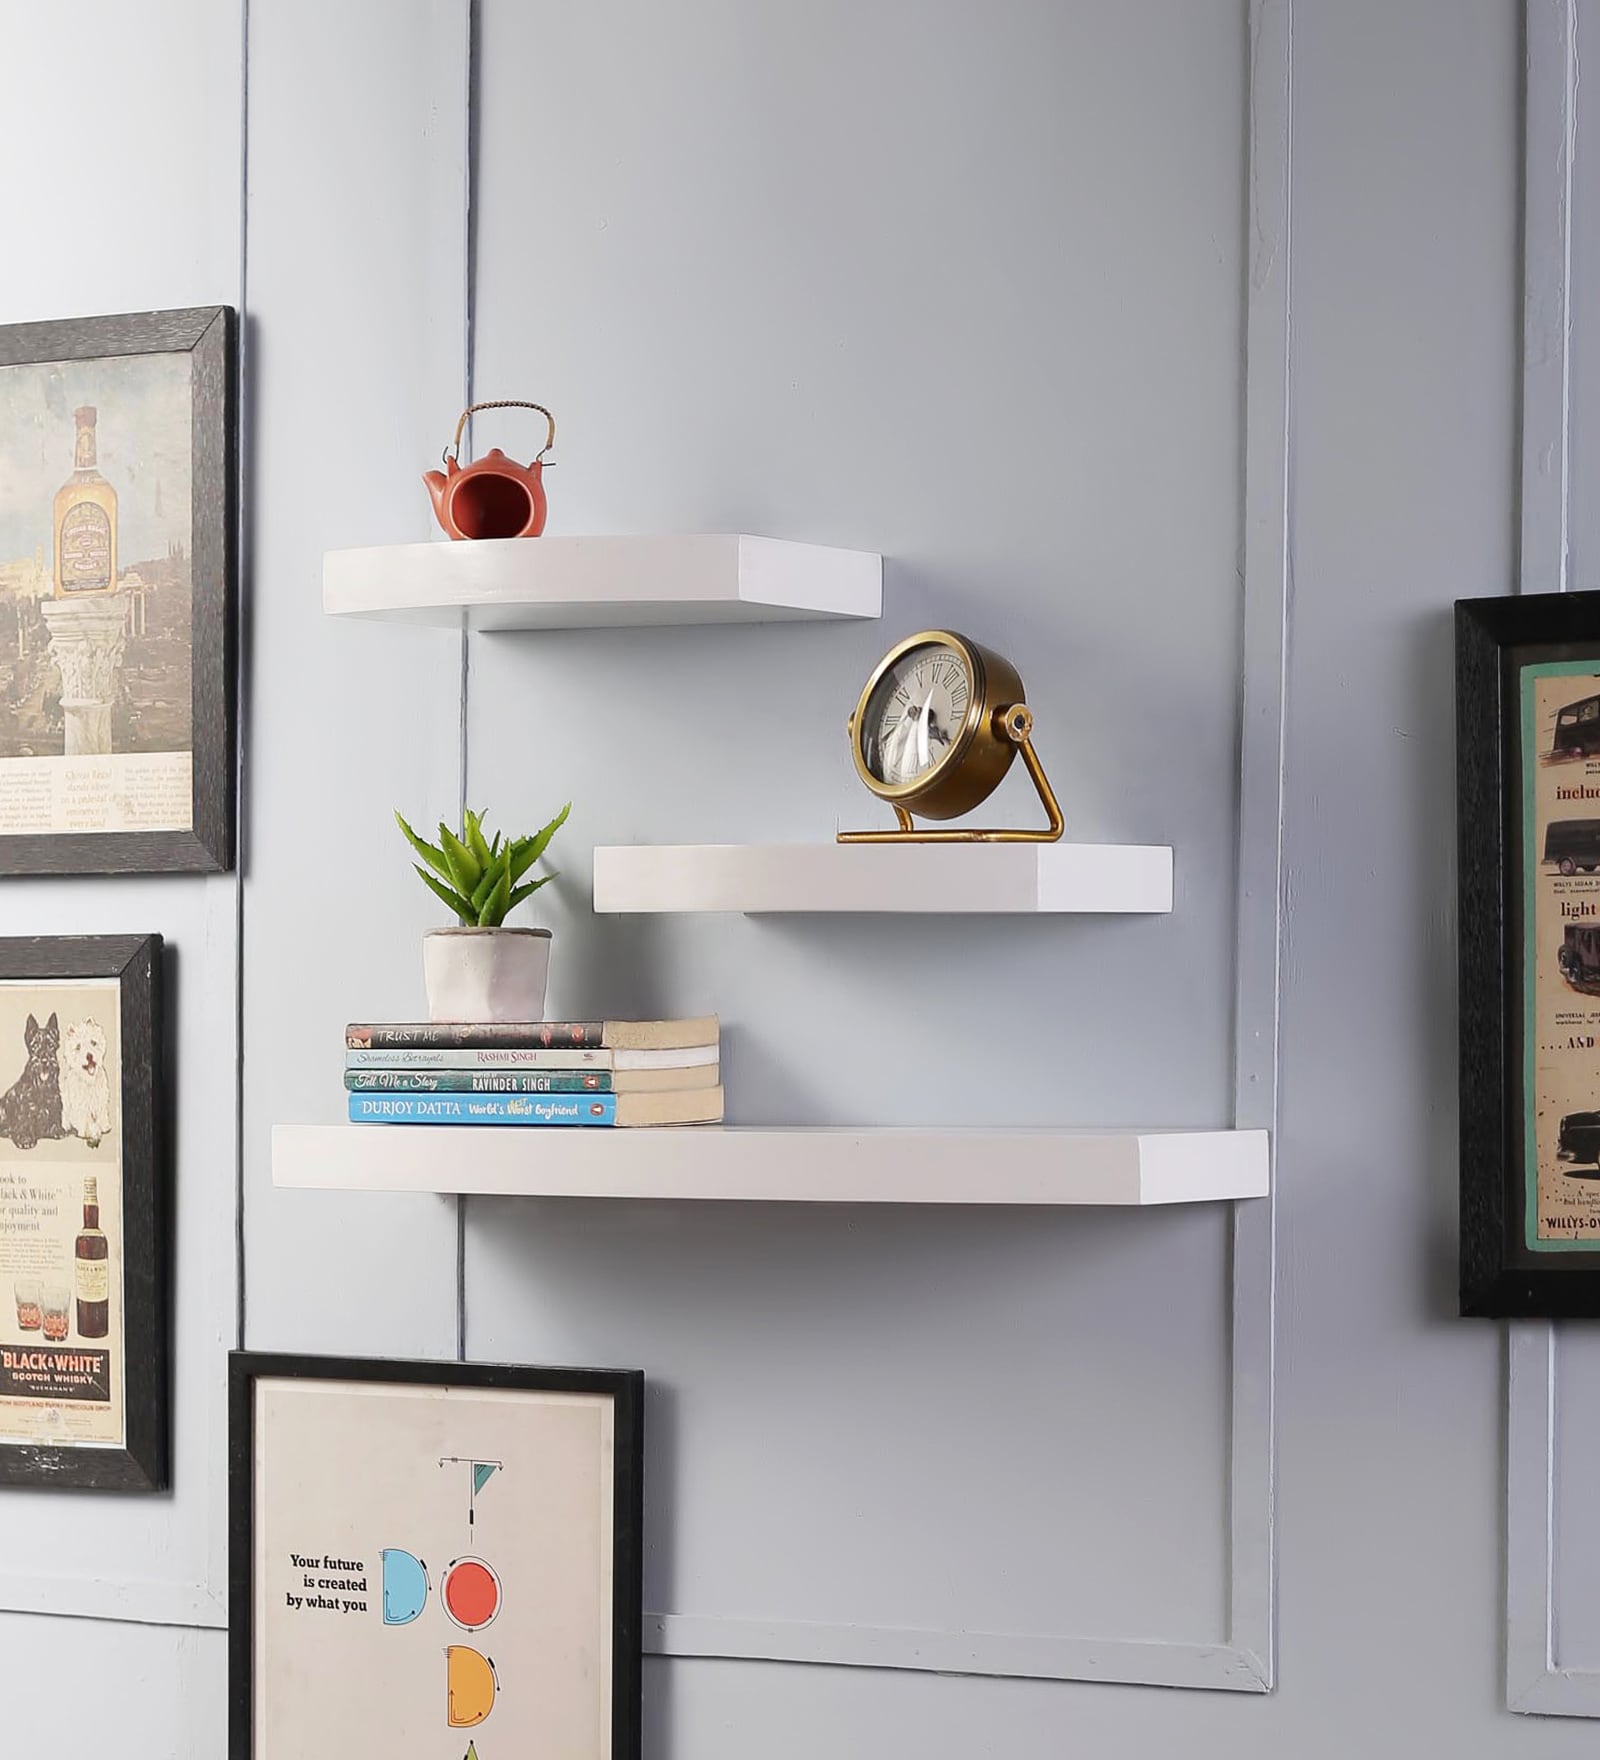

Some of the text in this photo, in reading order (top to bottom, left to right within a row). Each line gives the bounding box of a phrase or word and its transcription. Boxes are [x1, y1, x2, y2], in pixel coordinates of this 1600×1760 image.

[1560, 901, 1596, 920] light
[377, 1030, 440, 1042] TRUST ME
[1567, 1036, 1595, 1049] AND
[357, 1051, 444, 1065] Shameless Betrayals
[477, 1051, 537, 1063] RASHMI SINGH
[355, 1074, 377, 1088] Tell
[379, 1073, 400, 1088] Me
[410, 1073, 439, 1091] Story
[472, 1078, 551, 1091] RAVINDER SINGH
[363, 1101, 461, 1115] DURJOY DATTA
[469, 1103, 505, 1115] World's
[535, 1103, 578, 1120] Boyfriend
[18, 1176, 27, 1184] to
[8, 1203, 39, 1218] quality
[41, 1205, 59, 1216] and
[12, 1372, 94, 1385] SCOTCH WHISKY
[290, 1554, 364, 1571] Your future
[303, 1574, 368, 1592] is created
[286, 1592, 368, 1614] by what you
